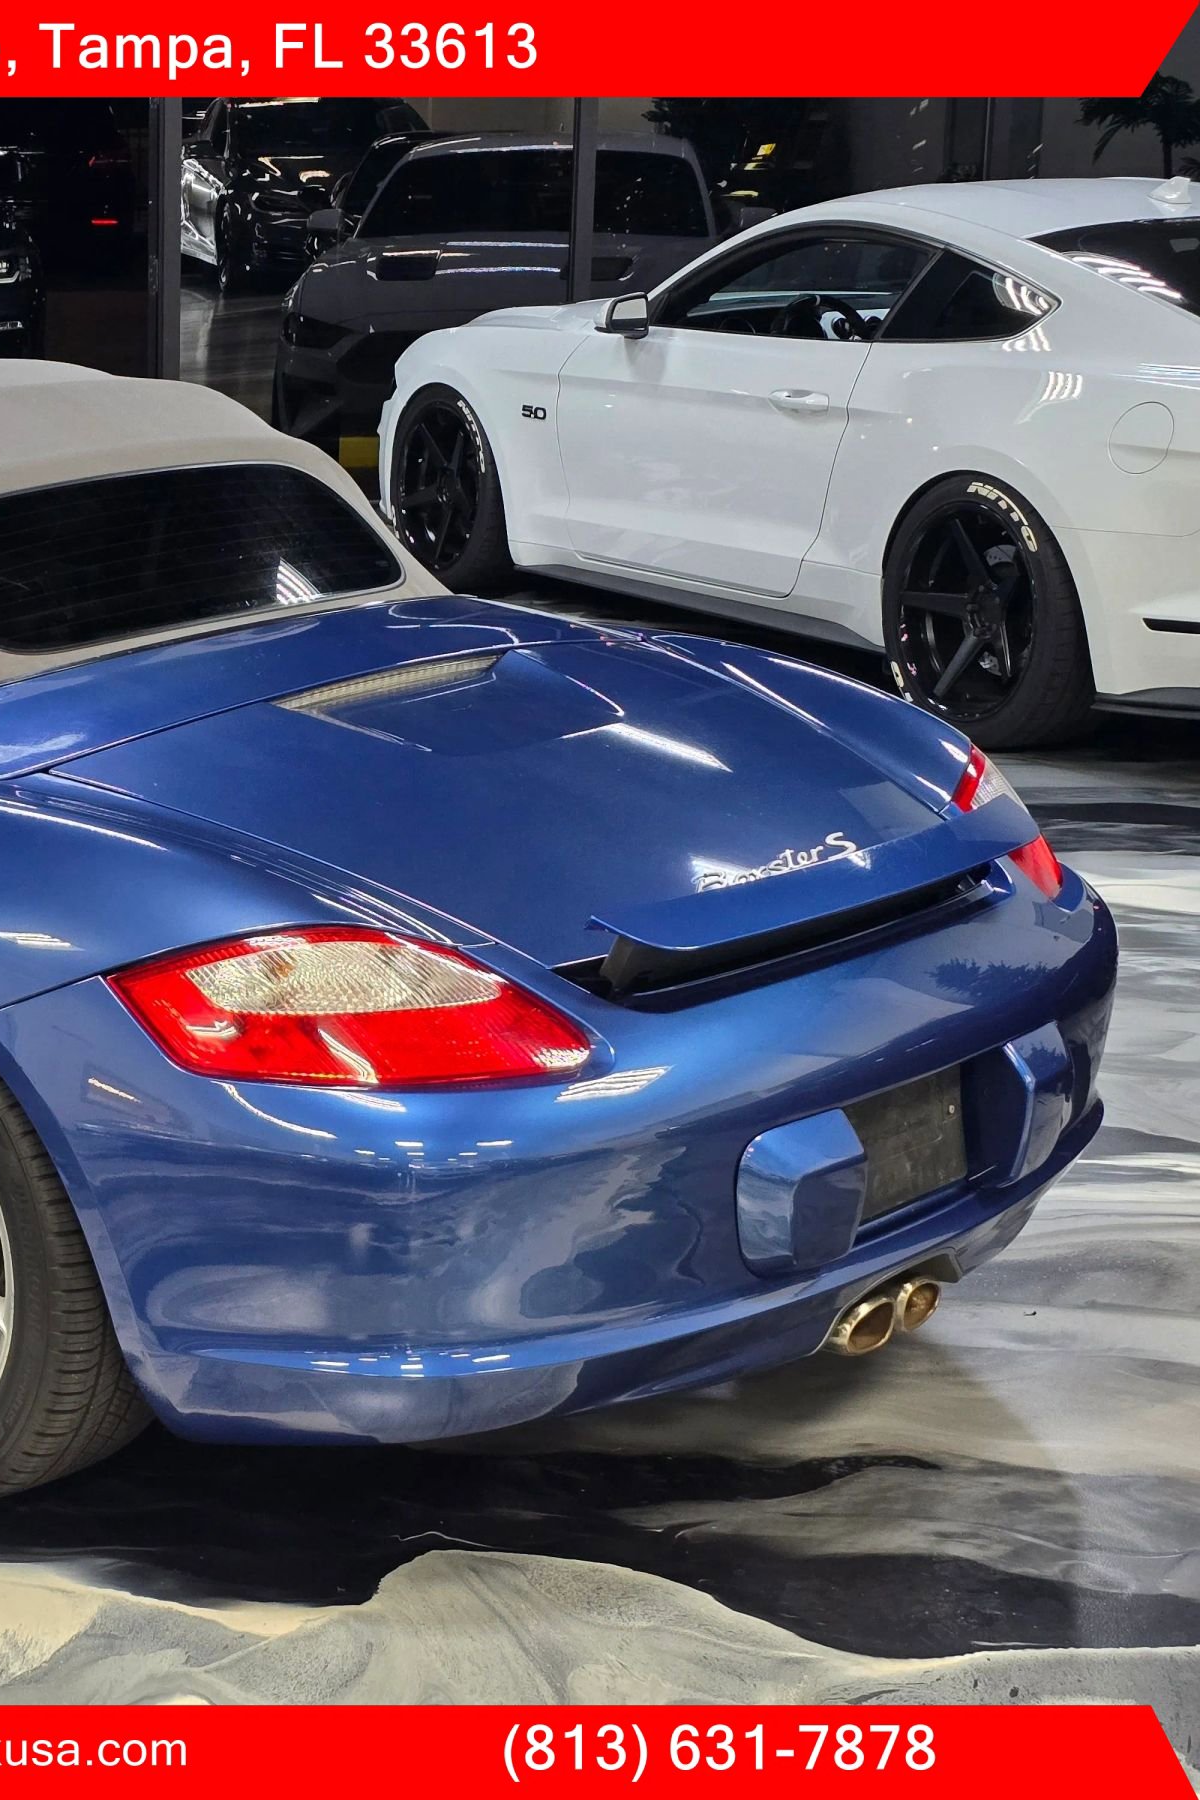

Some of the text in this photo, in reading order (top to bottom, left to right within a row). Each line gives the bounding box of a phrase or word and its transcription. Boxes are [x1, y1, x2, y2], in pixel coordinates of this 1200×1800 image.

[521, 404, 547, 421] 5.0
[966, 481, 1038, 553] NITTO
[825, 831, 857, 861] S
